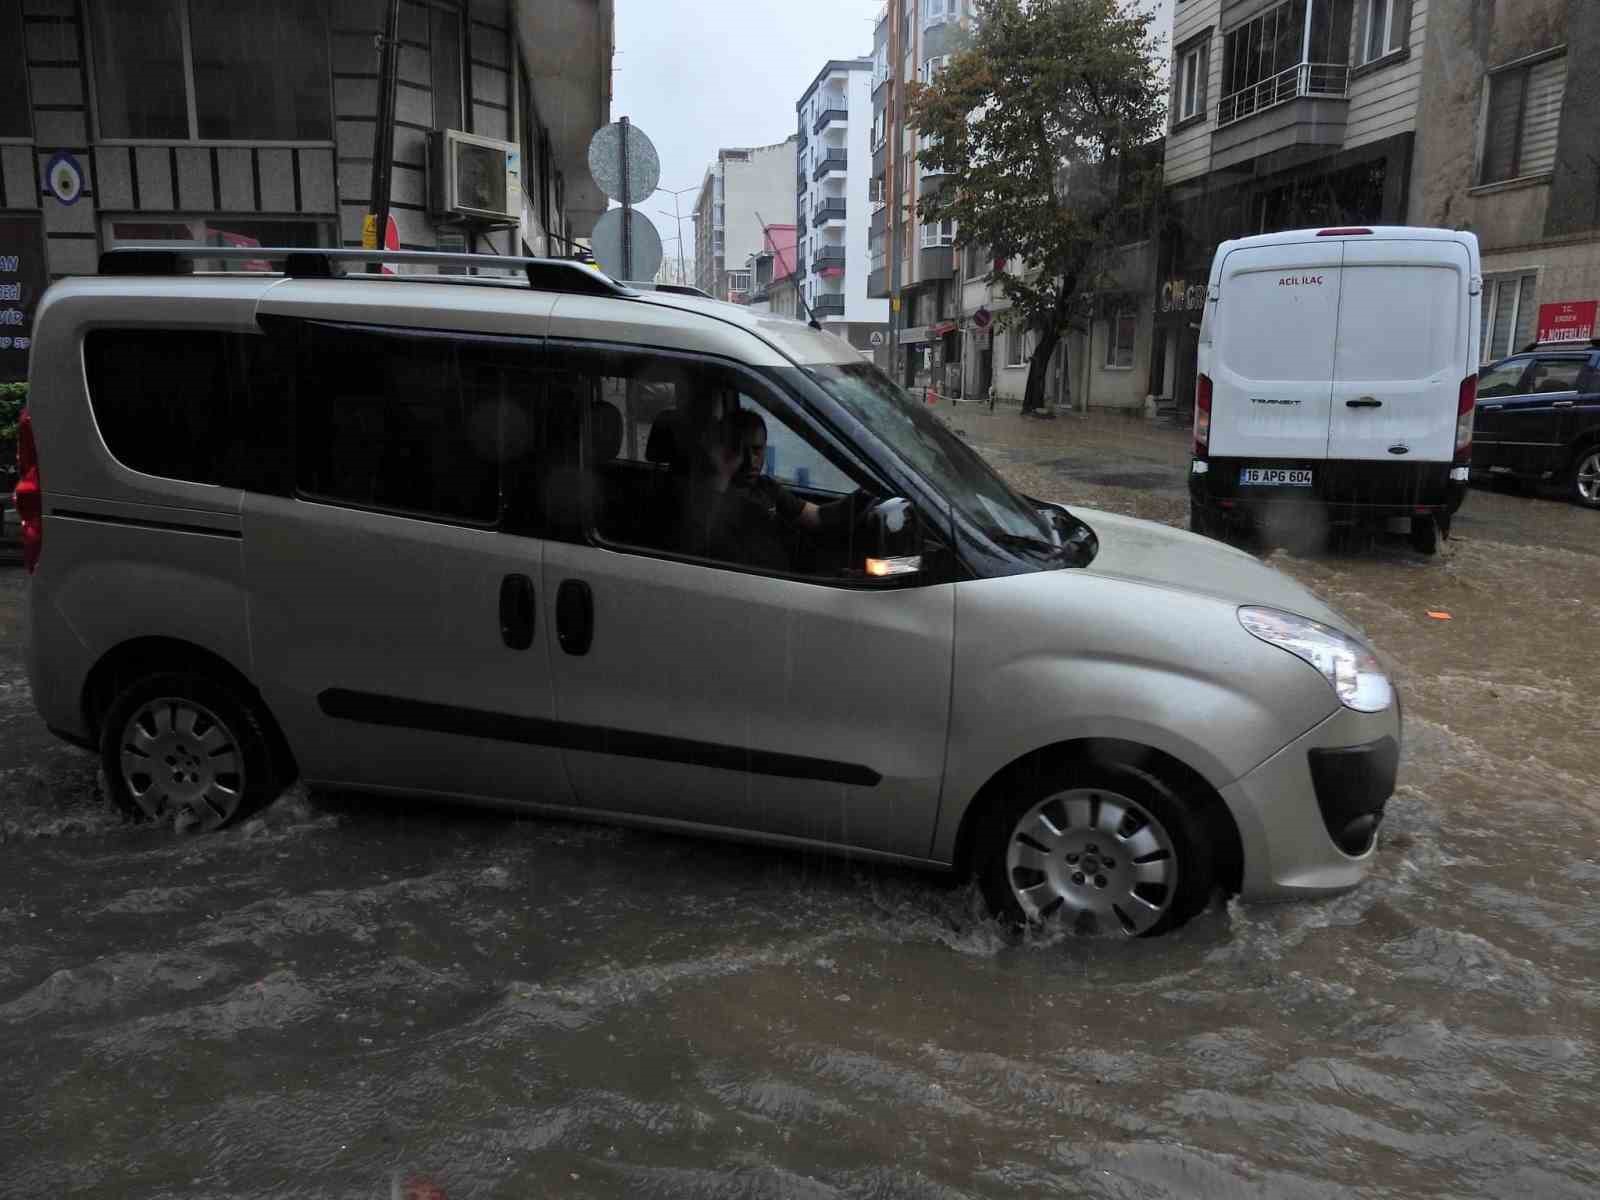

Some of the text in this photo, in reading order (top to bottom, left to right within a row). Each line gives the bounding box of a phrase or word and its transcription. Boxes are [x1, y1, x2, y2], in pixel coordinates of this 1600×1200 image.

[1248, 470, 1311, 483] 16 APG 604
